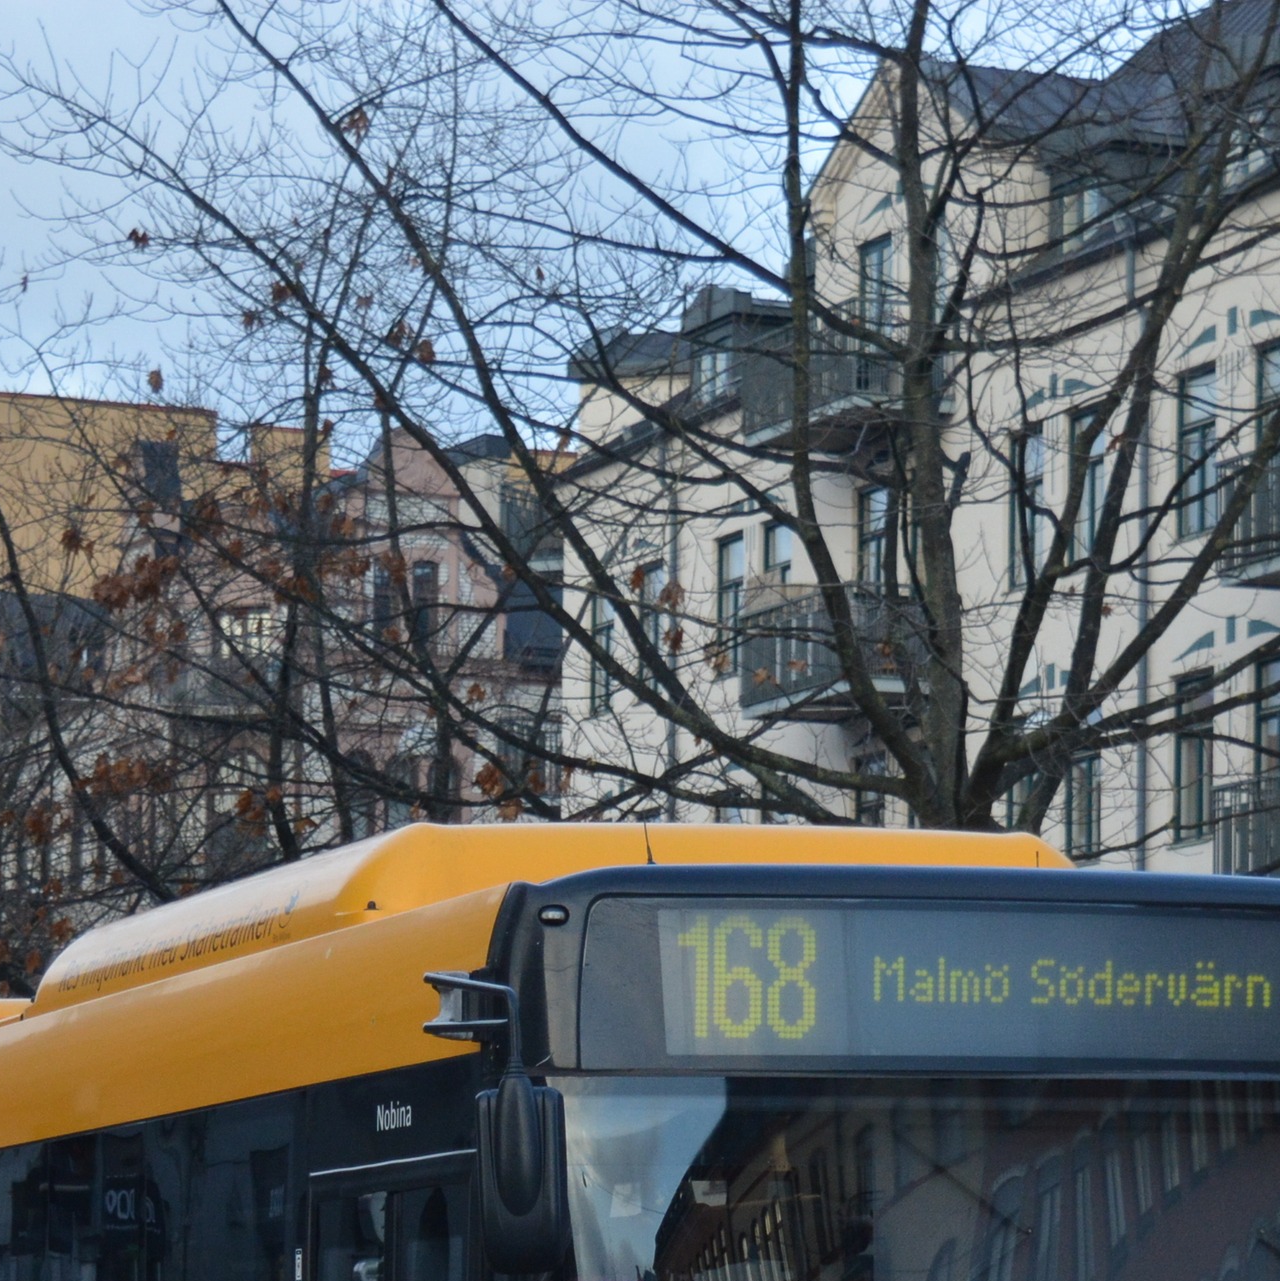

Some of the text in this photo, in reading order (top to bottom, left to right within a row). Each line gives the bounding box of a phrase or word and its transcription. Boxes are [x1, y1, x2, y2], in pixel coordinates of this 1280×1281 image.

[678, 915, 1271, 1039] 168 Malmö Södervärn
[377, 1101, 412, 1132] Nobina
